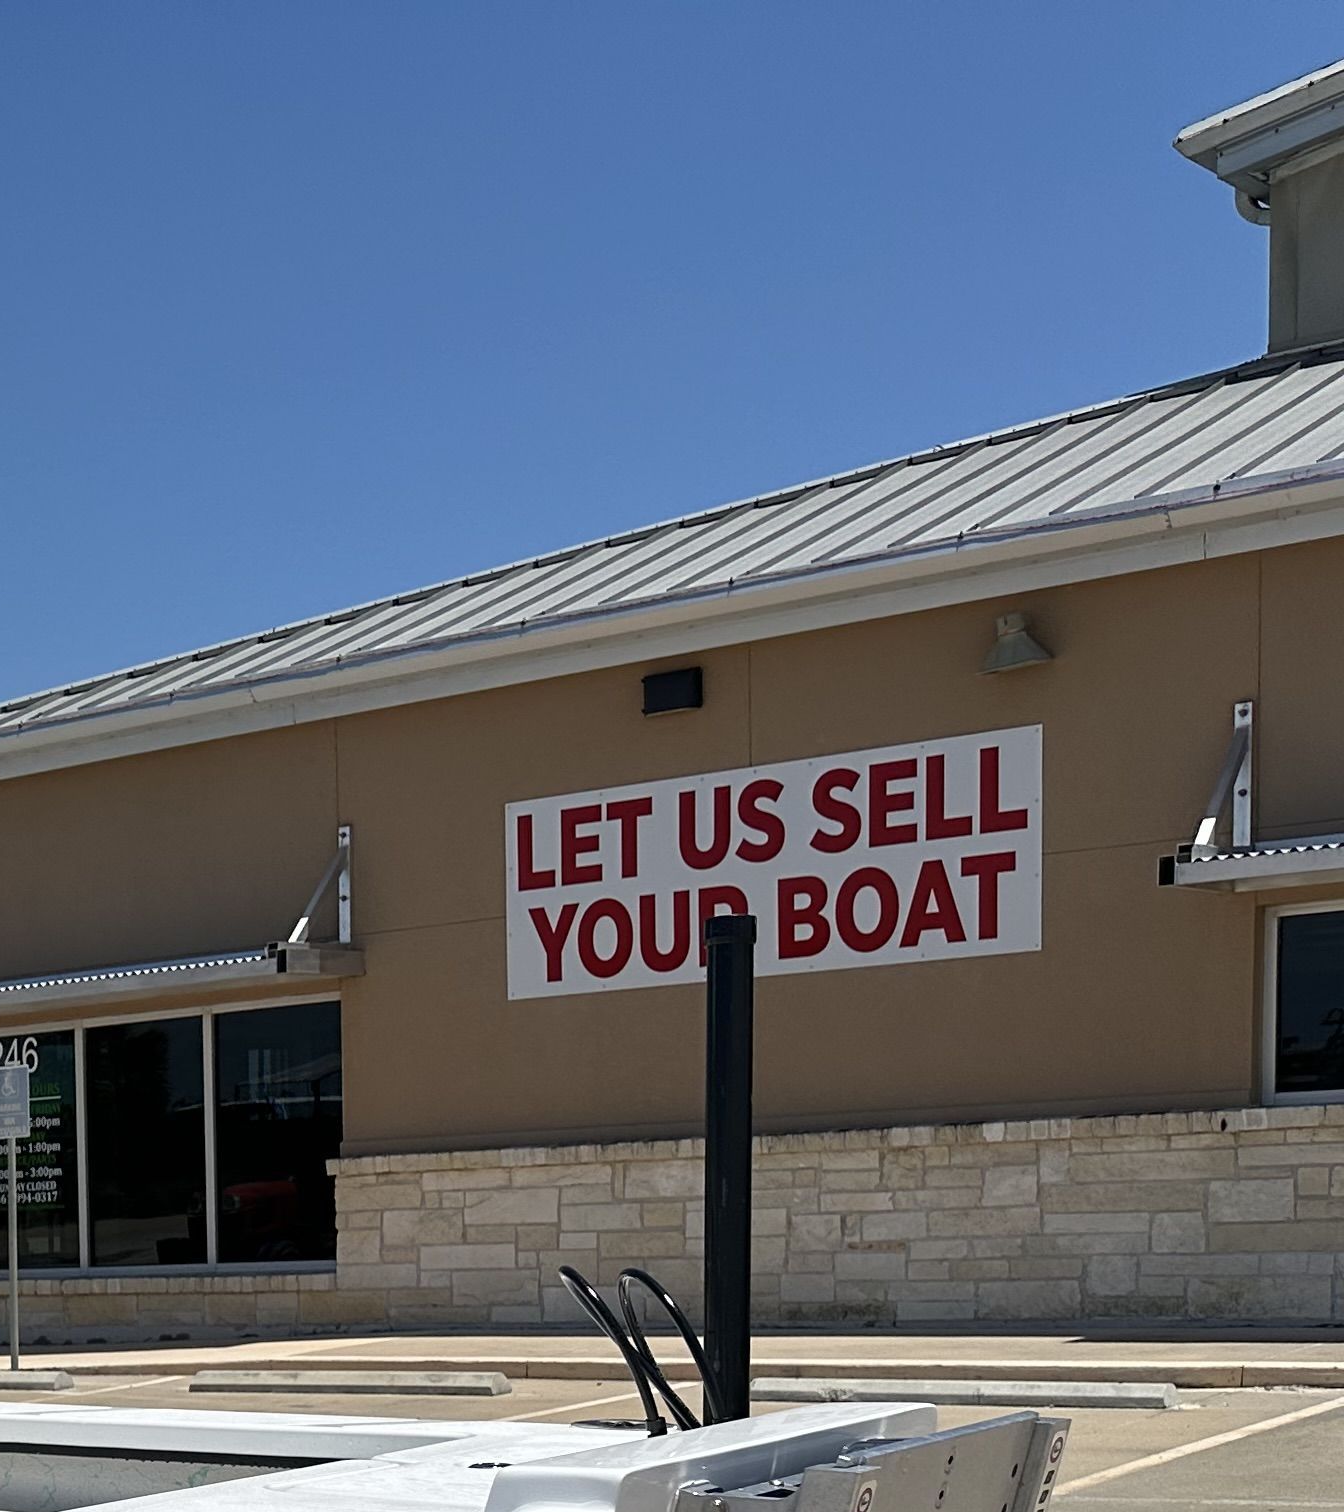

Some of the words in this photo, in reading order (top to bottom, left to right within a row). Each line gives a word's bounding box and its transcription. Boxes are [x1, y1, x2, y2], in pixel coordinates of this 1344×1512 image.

[517, 796, 653, 892] LET
[678, 779, 785, 870] US
[809, 746, 1028, 854] SELL
[777, 851, 1016, 960] BOAT
